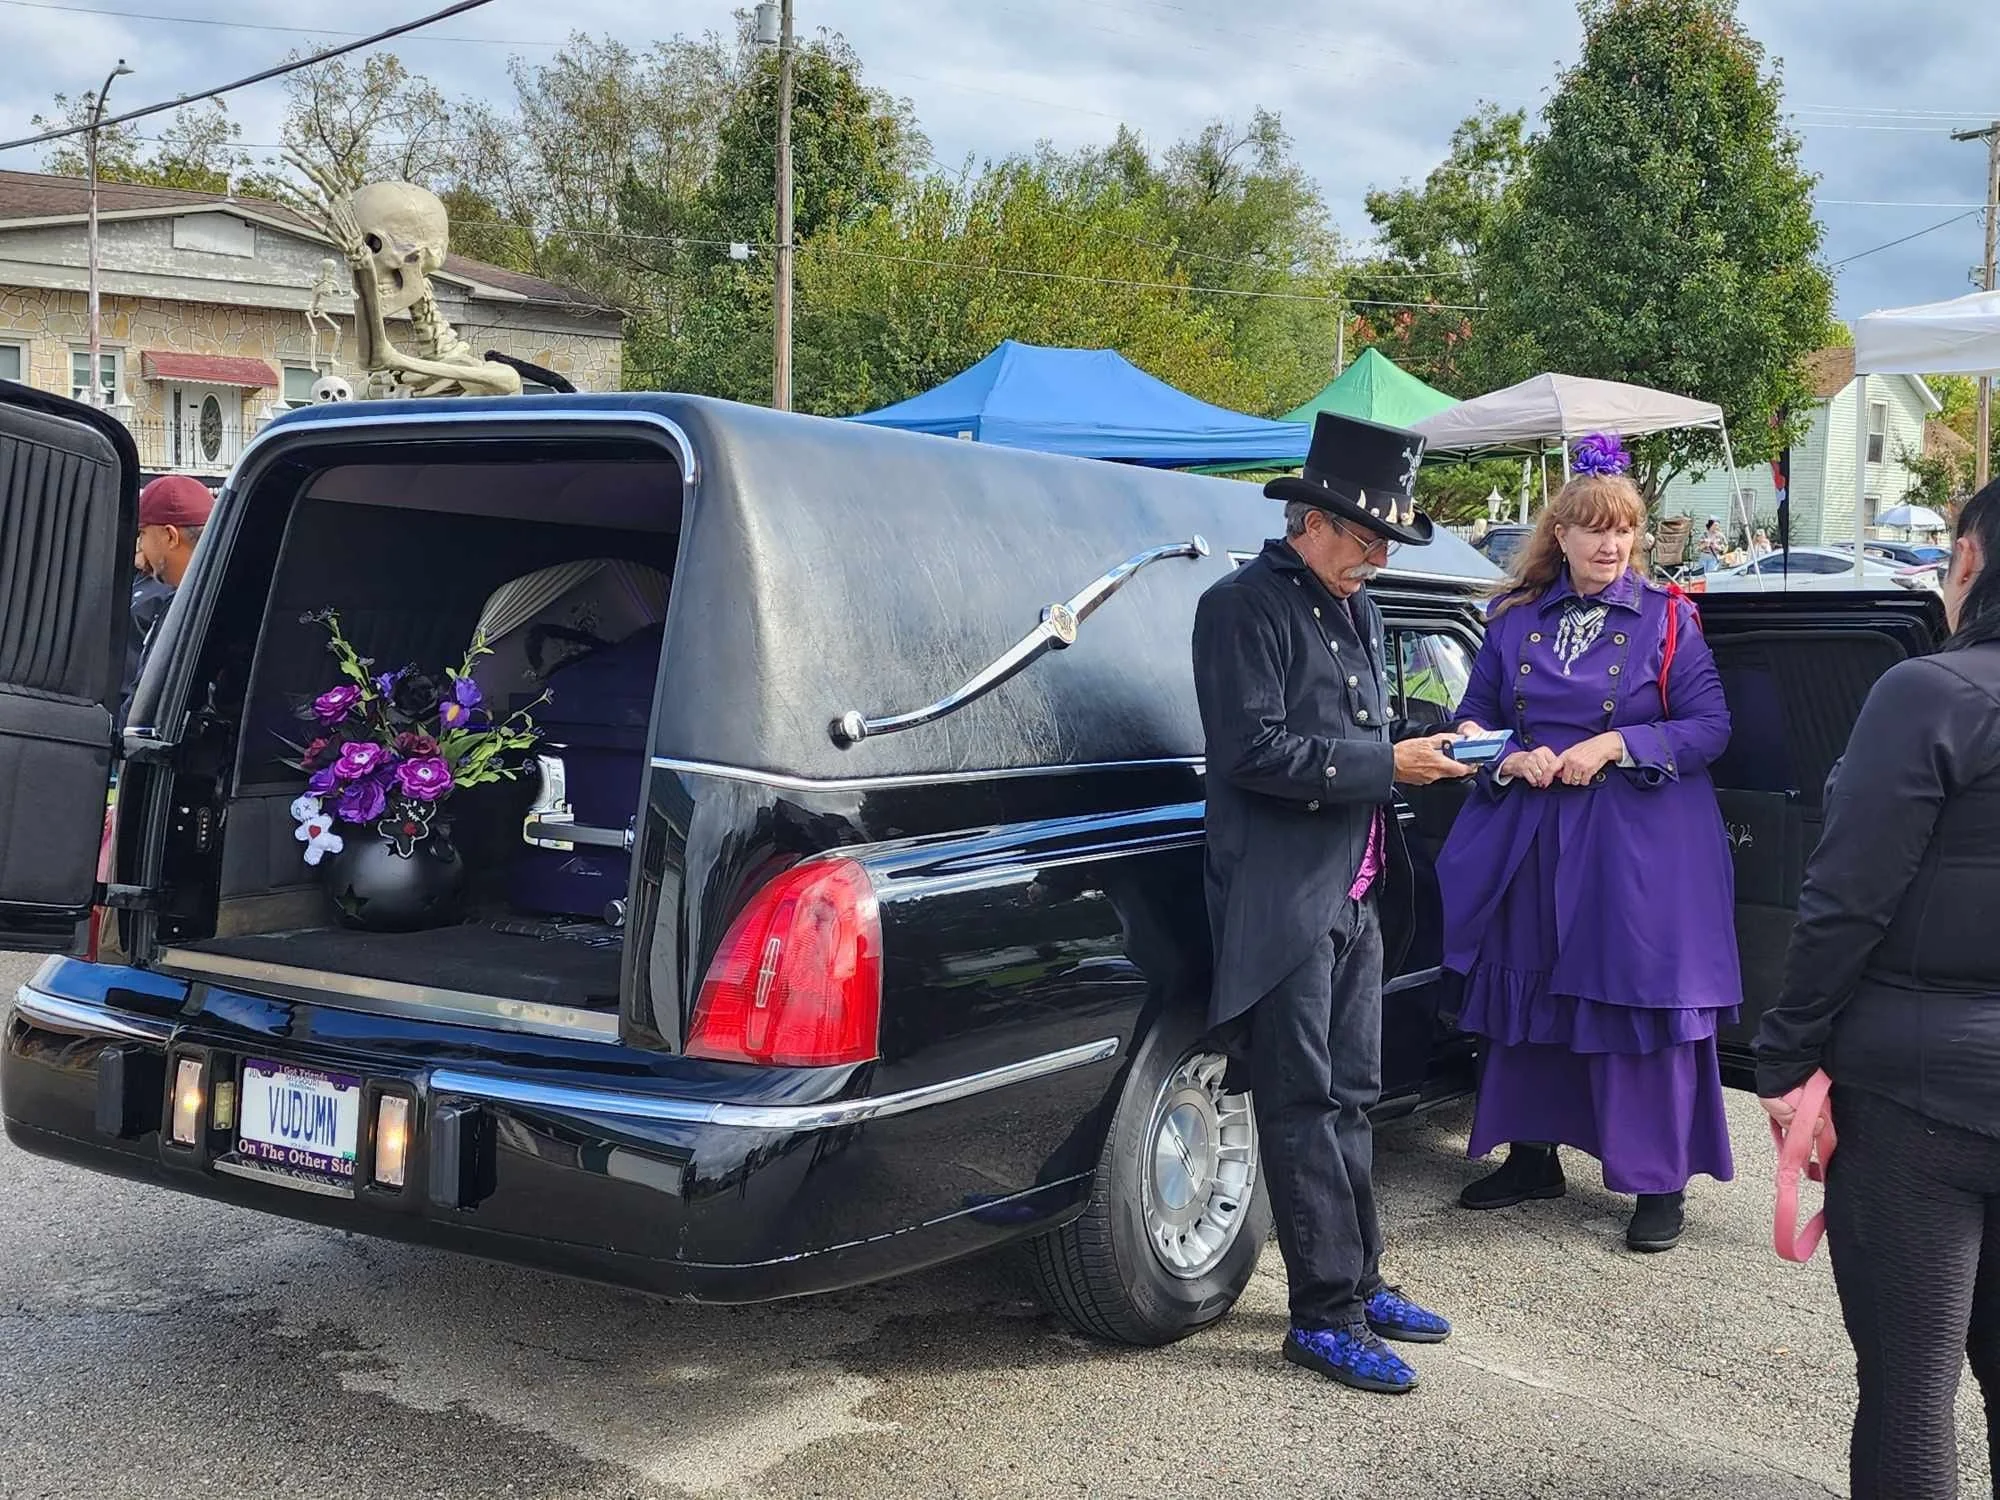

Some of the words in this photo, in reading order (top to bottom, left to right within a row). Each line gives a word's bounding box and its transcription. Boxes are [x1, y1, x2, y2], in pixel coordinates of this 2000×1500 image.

[284, 1066, 297, 1075] Got
[299, 1069, 328, 1081] Friends
[269, 1086, 338, 1147] VUDUMN
[238, 1139, 256, 1155] On
[260, 1142, 285, 1160] The
[288, 1150, 327, 1170] Other
[331, 1158, 355, 1175] Sid
